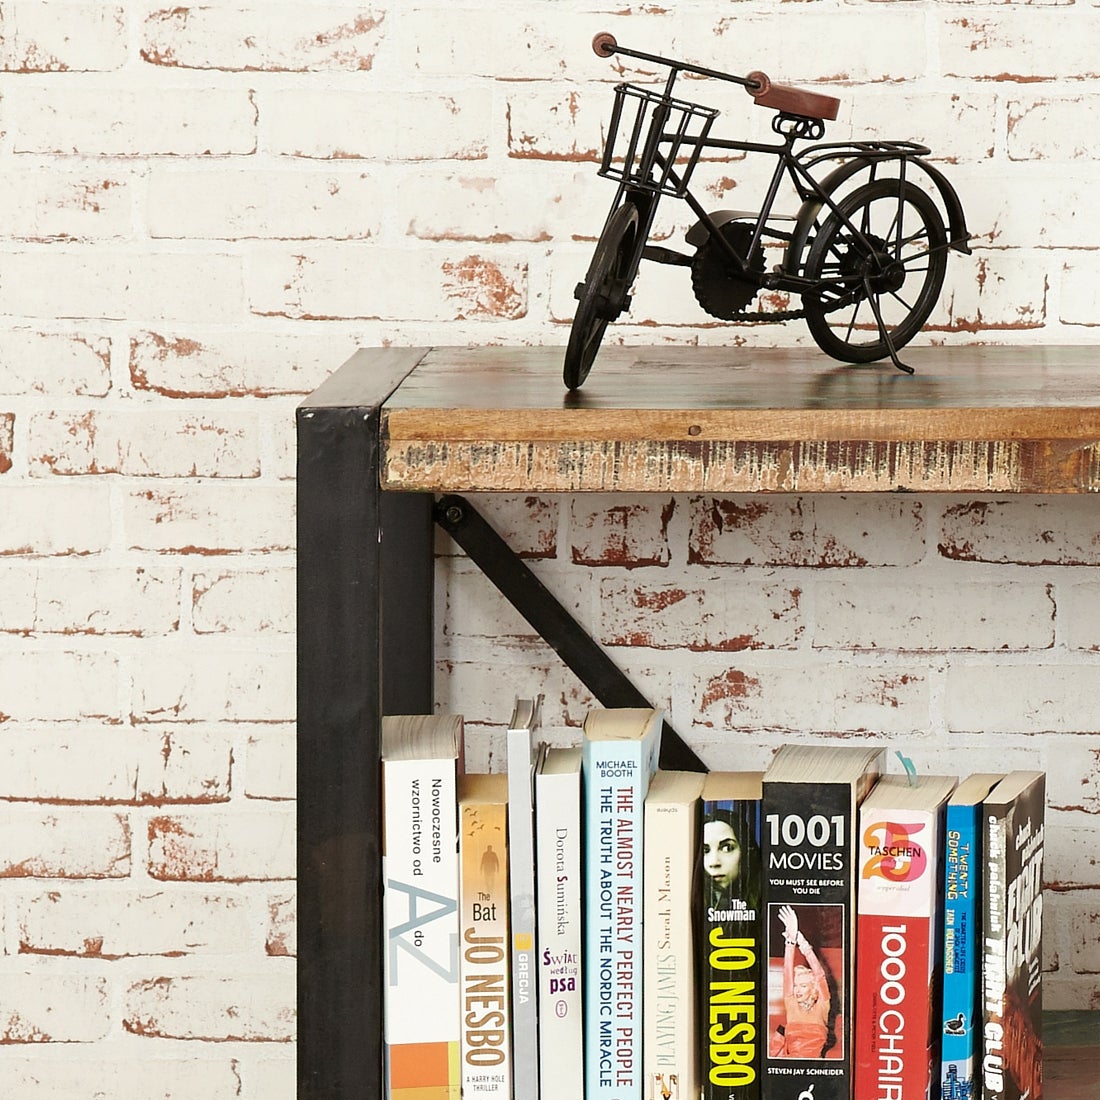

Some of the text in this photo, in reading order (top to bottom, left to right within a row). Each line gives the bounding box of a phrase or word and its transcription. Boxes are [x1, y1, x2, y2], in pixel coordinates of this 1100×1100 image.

[596, 760, 638, 769] MICHAEL
[600, 769, 633, 778] BOOTH
[412, 779, 423, 876] wzornictwo od
[432, 779, 442, 863] Nowoczesne
[766, 814, 845, 847] 1001
[988, 815, 999, 859] chuck
[769, 852, 844, 870] MOVIES
[868, 846, 921, 857] TASCHEN
[947, 831, 961, 900] SOMETHING
[959, 843, 970, 898] TWENTY
[477, 892, 491, 901] The
[657, 856, 671, 949] Sarah Mason
[731, 898, 747, 910] The
[793, 887, 820, 895] YOU DIE
[818, 879, 844, 887] BEFORE
[472, 903, 497, 921] Bat
[557, 875, 570, 936] Sumińska
[707, 908, 756, 922] Snowman
[388, 878, 459, 986] A do Z
[600, 786, 612, 1087] THE TRUTH ABOUT THE NORDIC MIRACLE
[616, 786, 633, 1087] THE ALMOST NEARLY PERFECT PEOPLE
[518, 953, 529, 1004] GRECJA
[549, 977, 576, 995] psa
[880, 924, 907, 1006] 1000
[464, 927, 506, 1067] JO NESBO
[656, 954, 678, 1067] PLAYING JAMES
[709, 927, 756, 1087] JO NESBO
[984, 937, 1004, 1093] FIGHT CLUB
[471, 1075, 489, 1083] HARRY
[473, 1084, 499, 1092] THRILLER
[767, 1067, 844, 1076] STEVEN JAY SCHNEIDER
